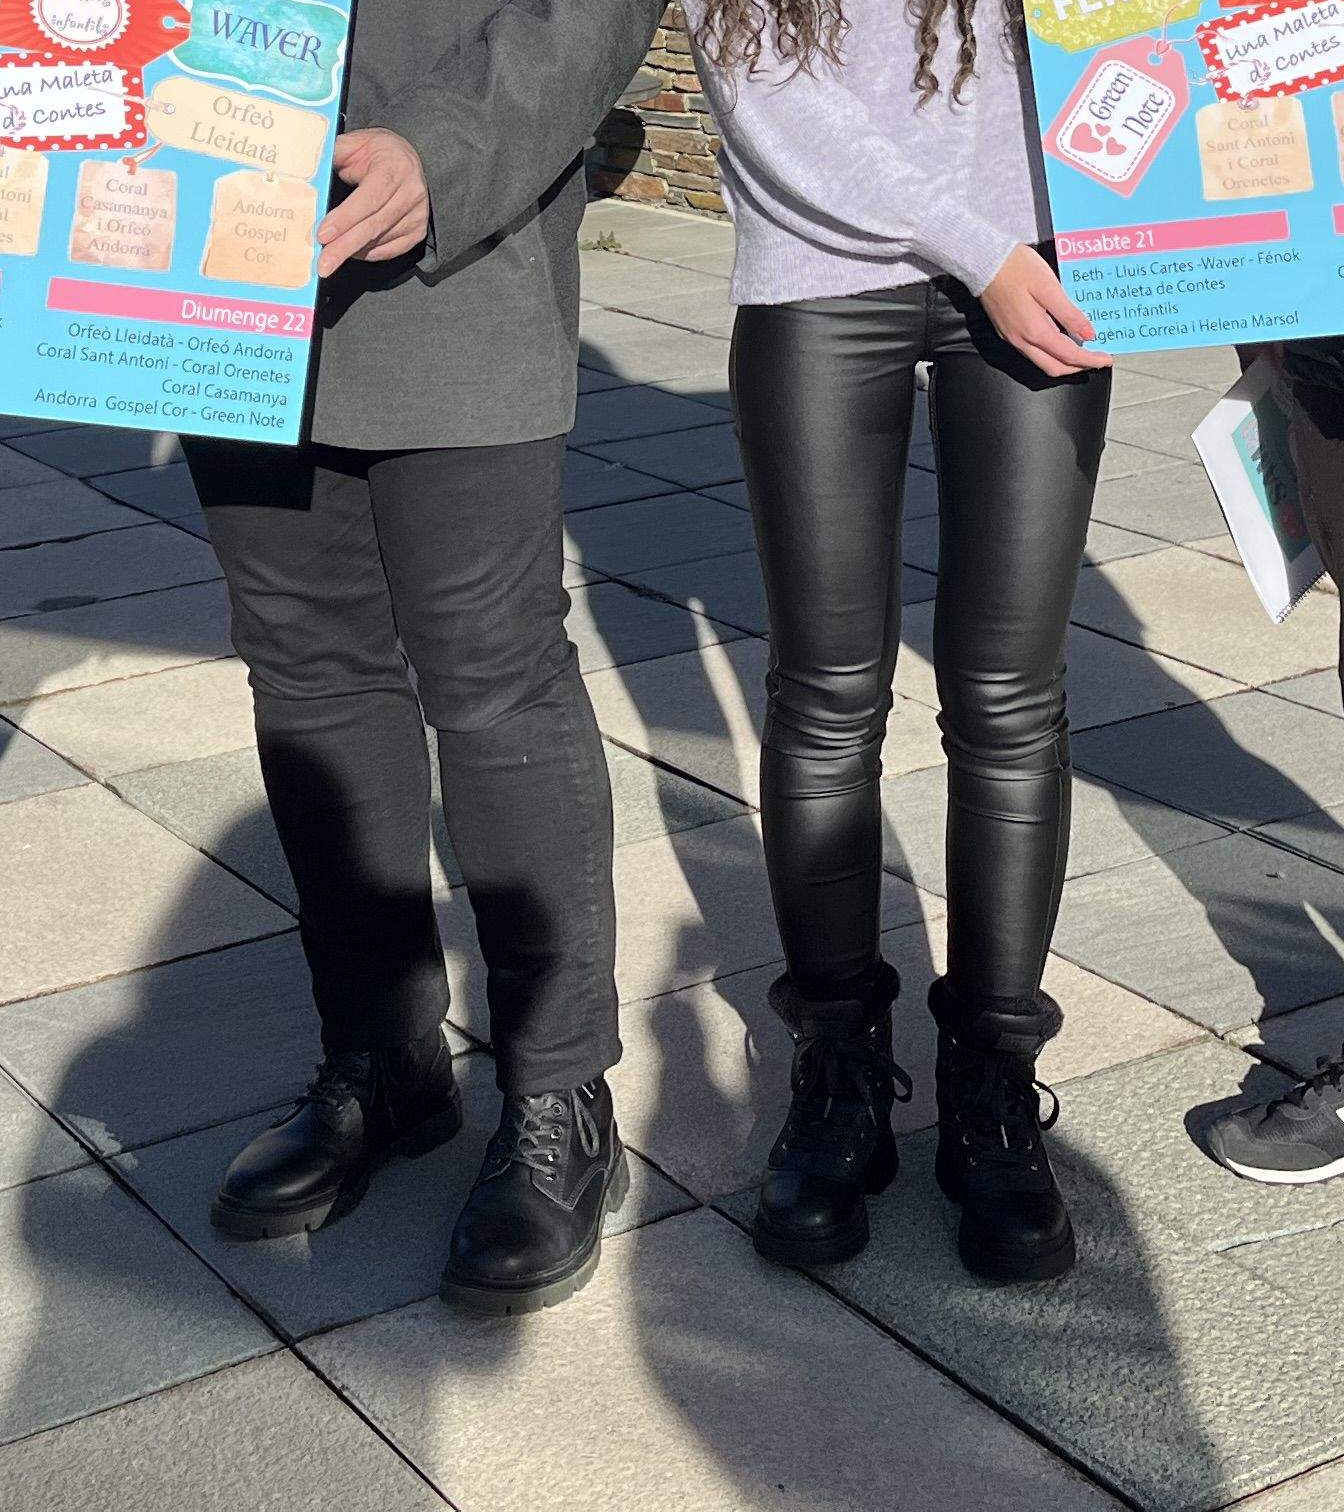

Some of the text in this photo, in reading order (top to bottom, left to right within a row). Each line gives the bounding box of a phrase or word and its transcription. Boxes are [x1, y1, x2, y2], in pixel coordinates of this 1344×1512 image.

[213, 8, 324, 69] WAVER
[1225, 2, 1340, 61] Una Maleta
[1274, 33, 1342, 72] Contes
[40, 69, 114, 92] Maleta
[1088, 71, 1133, 121] Green
[33, 100, 106, 125] Contes
[1121, 92, 1165, 138] Note
[1227, 114, 1269, 131] Coral
[1205, 131, 1295, 153] Sant Antoni
[1236, 152, 1279, 169] Coral
[104, 177, 148, 196] Coral
[1221, 173, 1289, 190] Orenetes
[79, 194, 168, 221] Casamanya
[232, 198, 295, 220] Andorra
[233, 221, 287, 244] Gospel
[1058, 229, 1154, 256] Dissabte 21
[243, 247, 272, 264] Cor
[1072, 267, 1104, 282] Beth
[1149, 260, 1193, 275] Cartes
[1074, 277, 1225, 303] Una Maleta de Contes
[180, 299, 305, 333] Diumenge 22
[1086, 301, 1178, 322] allers Infantils
[1138, 311, 1298, 338] Correia i Helena Marsol
[36, 341, 290, 384] Coral Sant Antoni Coral Orenetes
[161, 378, 287, 409] Coral Casamanya
[33, 387, 285, 429] Andorra Gospel Cor Green Note
